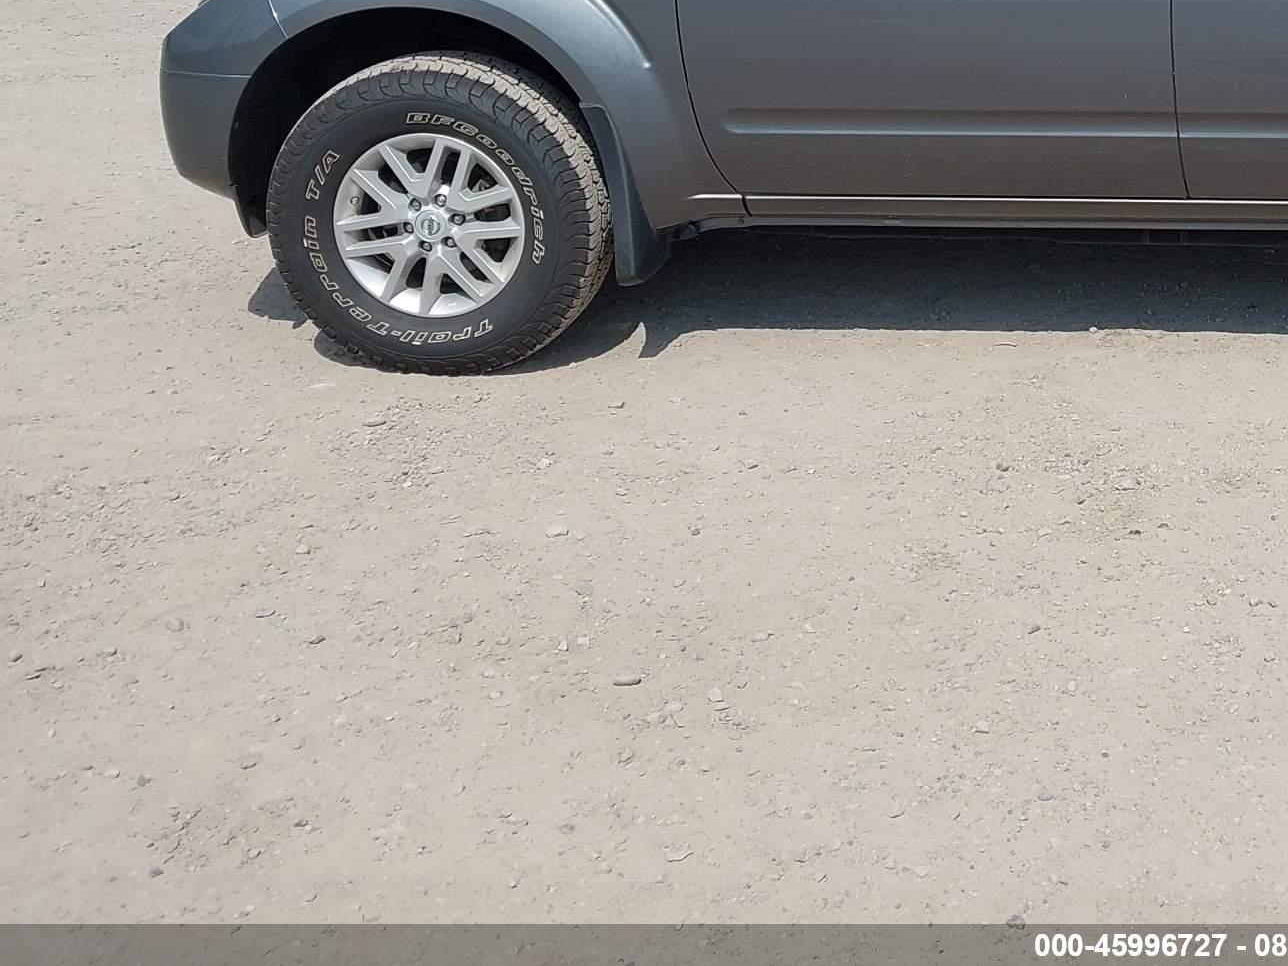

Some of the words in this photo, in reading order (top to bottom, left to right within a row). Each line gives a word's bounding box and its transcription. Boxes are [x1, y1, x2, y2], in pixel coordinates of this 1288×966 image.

[305, 149, 341, 201] T/A
[405, 112, 547, 266] BFGoodrich
[303, 215, 494, 346] Trail-Terrain
